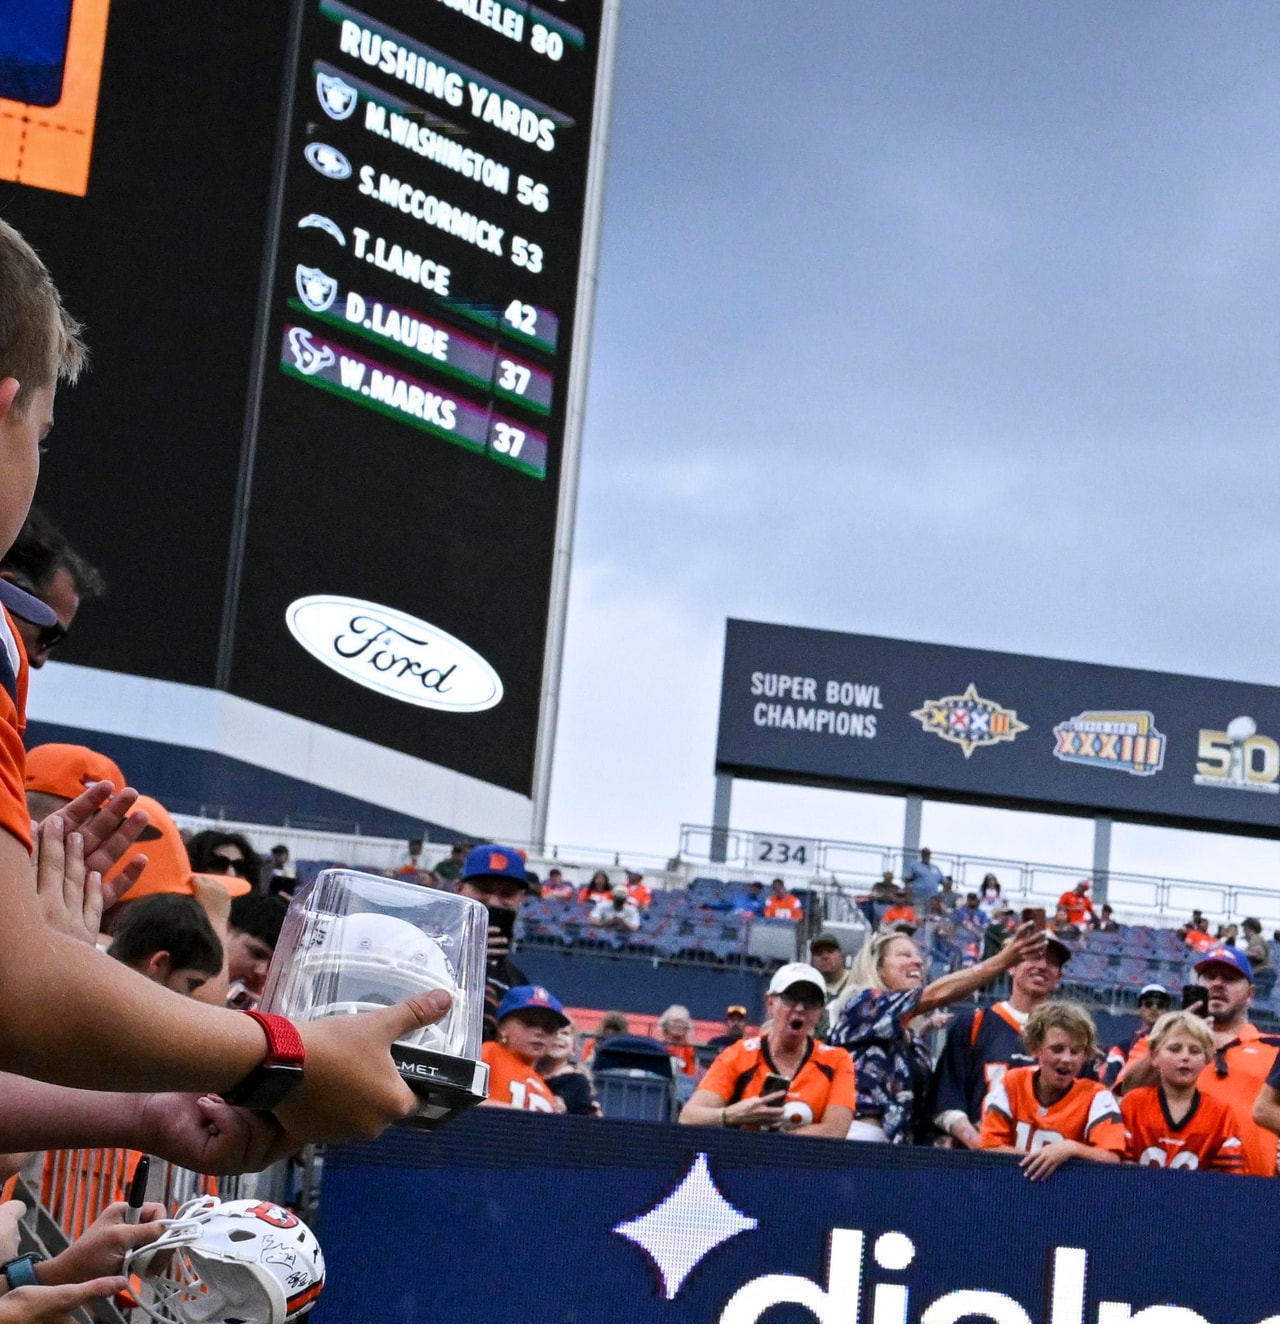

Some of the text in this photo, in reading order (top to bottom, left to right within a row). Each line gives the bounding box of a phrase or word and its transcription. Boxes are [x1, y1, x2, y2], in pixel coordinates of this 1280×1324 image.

[340, 20, 555, 152] RUSHING YARDS
[530, 24, 564, 61] 80
[364, 102, 549, 213] M.WASHINGTON 56
[358, 166, 543, 273] S.MCCORMICK 53
[353, 228, 537, 336] T.LANCE 42
[346, 291, 531, 395] D.LAUBE 37
[339, 356, 525, 458] W.MARKS 37
[334, 615, 459, 693] Ford
[750, 671, 883, 711] SUPER BOWL
[753, 702, 877, 739] CHAMPIONS
[1196, 728, 1280, 784] 50
[758, 841, 807, 866] 234
